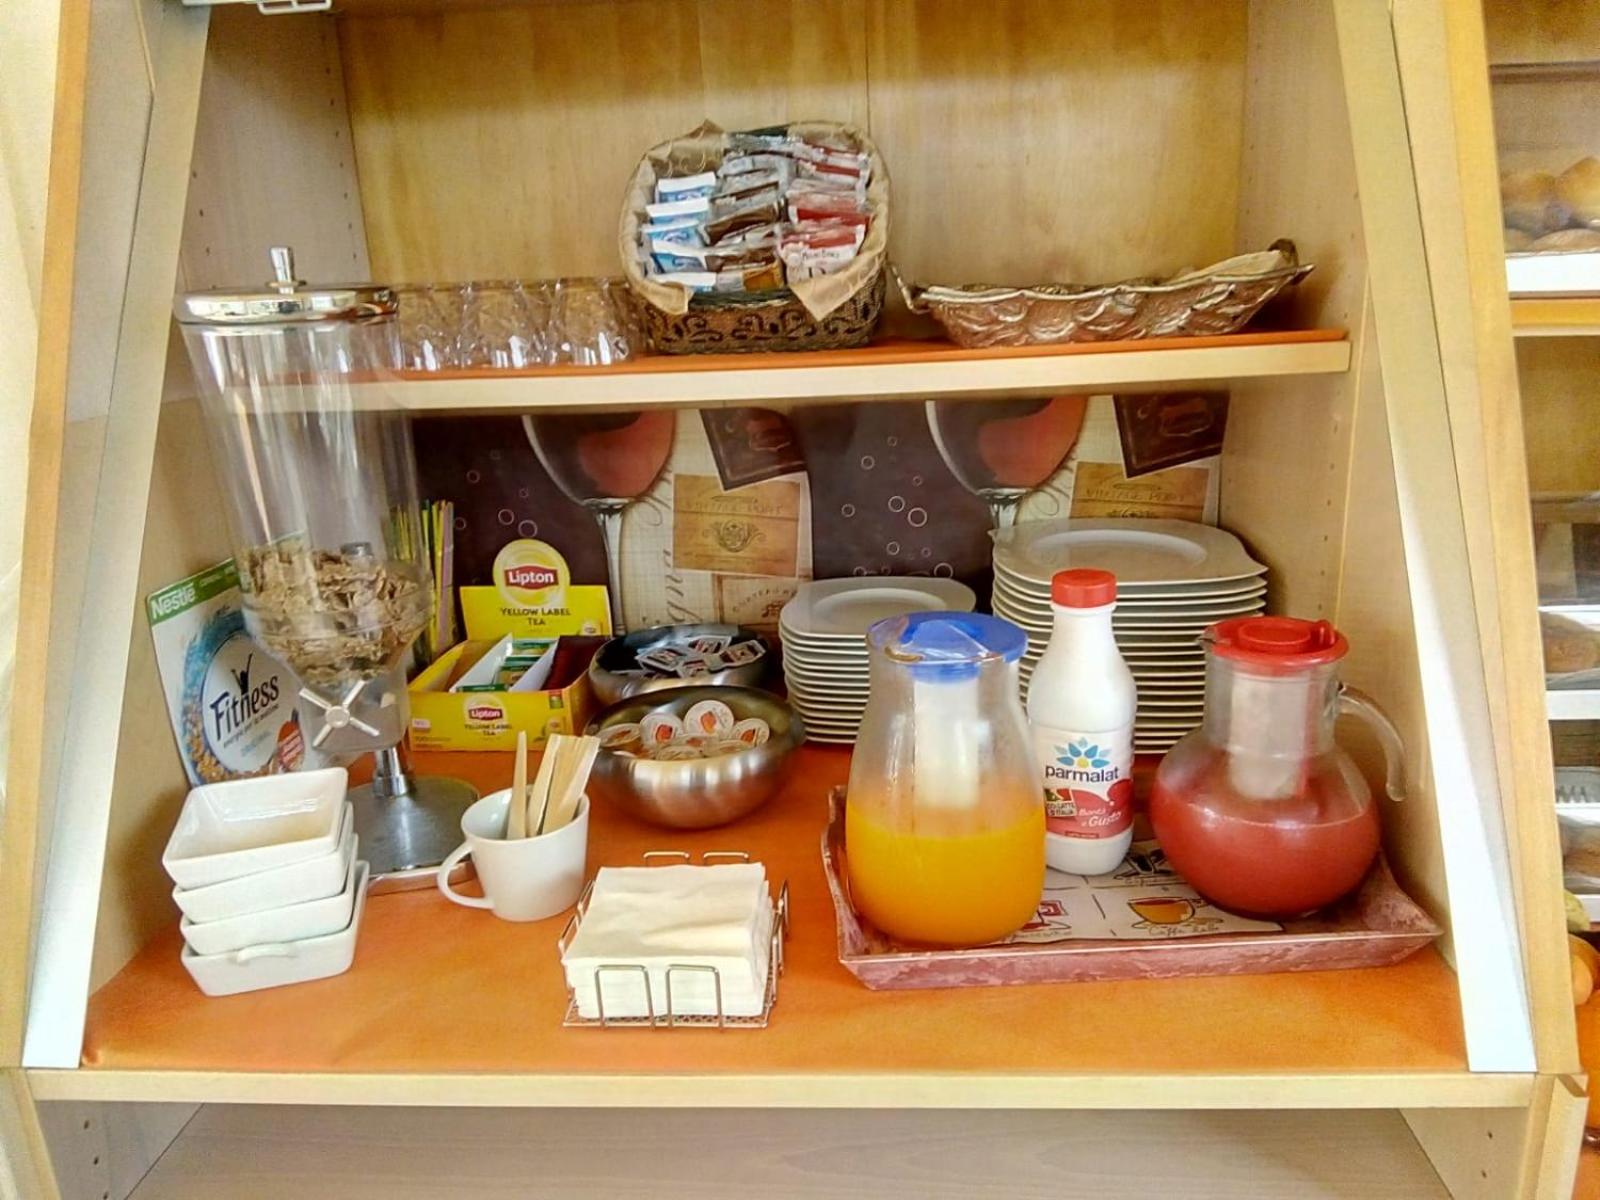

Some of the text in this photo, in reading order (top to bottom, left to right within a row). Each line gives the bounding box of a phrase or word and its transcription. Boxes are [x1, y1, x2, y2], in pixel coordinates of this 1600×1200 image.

[507, 571, 555, 585] Lipton
[501, 607, 572, 616] YELLOW LABEL
[527, 617, 546, 626] TEA
[209, 675, 280, 742] Fitness
[471, 709, 501, 719] Lipton
[1045, 764, 1119, 783] parmalat
